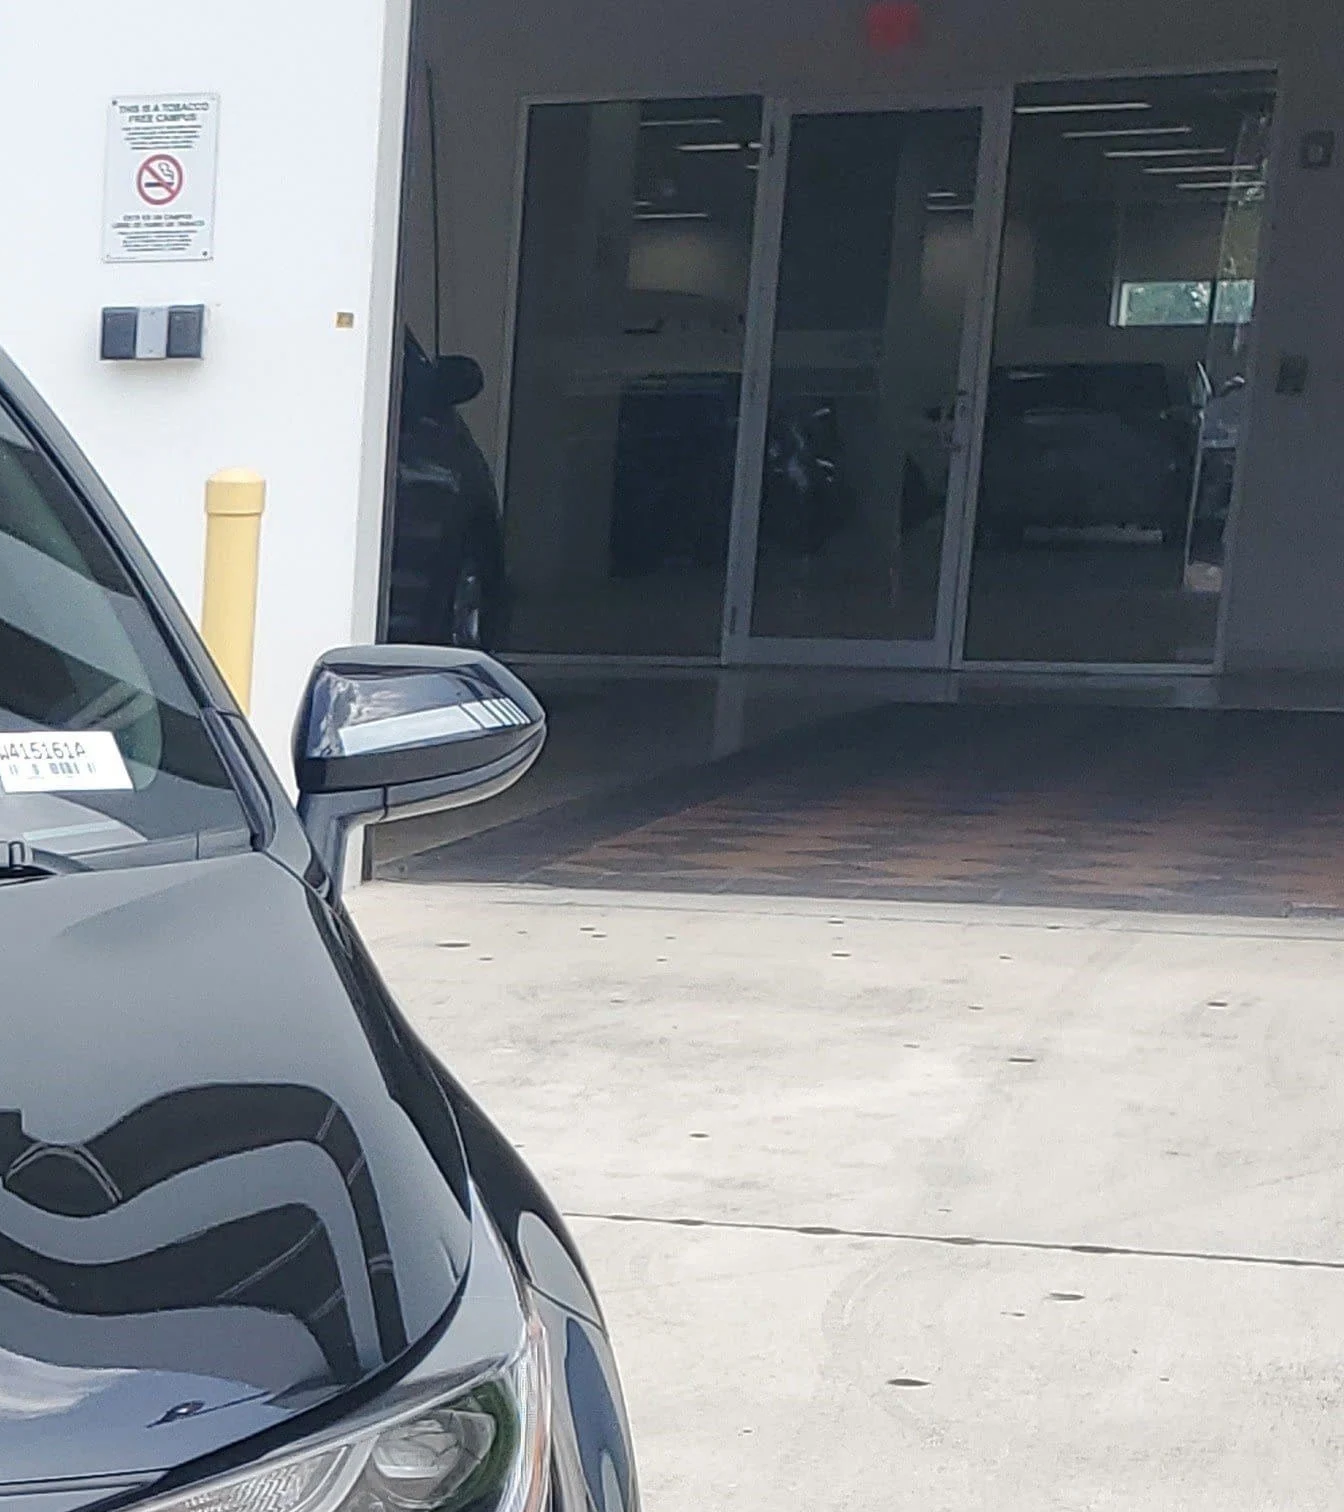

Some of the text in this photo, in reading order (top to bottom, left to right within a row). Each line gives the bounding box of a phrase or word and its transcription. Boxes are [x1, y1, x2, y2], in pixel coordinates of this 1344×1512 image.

[119, 102, 209, 113] THIS IS A TOBACCO
[129, 113, 196, 123] FREE CAMPUS
